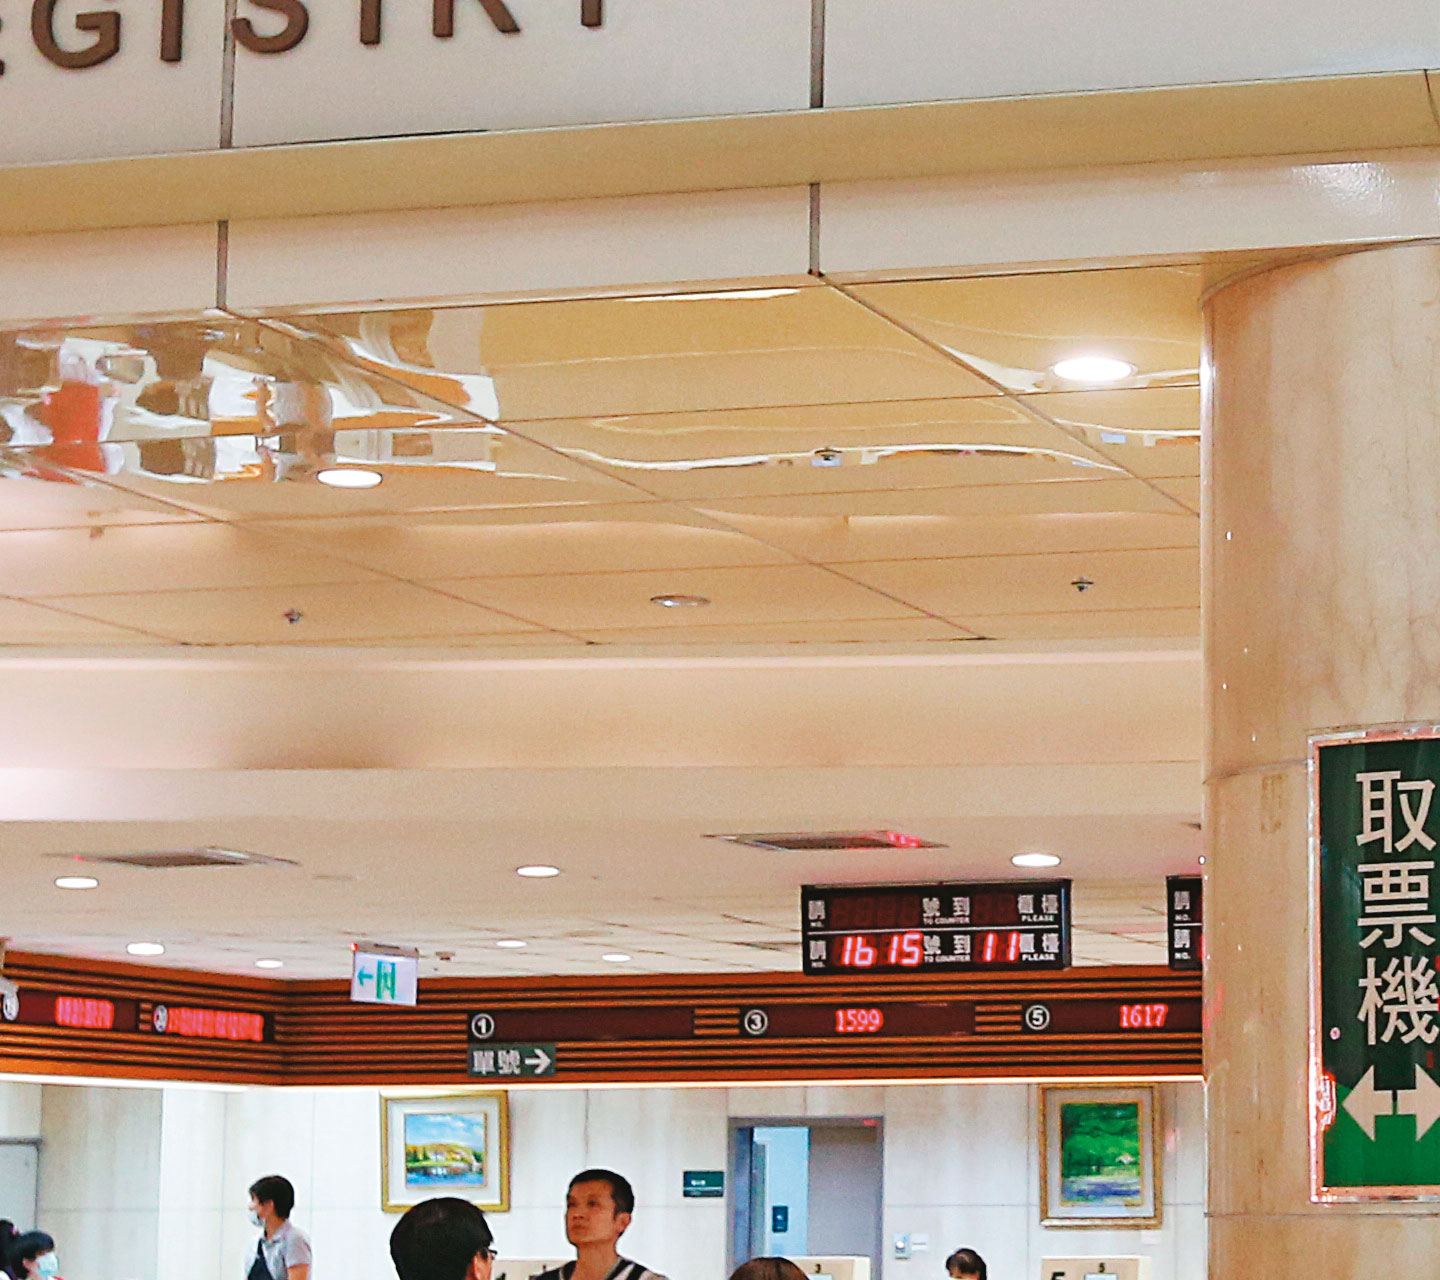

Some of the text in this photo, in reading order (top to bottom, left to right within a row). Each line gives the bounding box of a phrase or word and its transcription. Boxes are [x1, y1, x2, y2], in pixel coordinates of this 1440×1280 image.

[1021, 914, 1054, 922] PLEASE
[1355, 769, 1440, 1046] 取票機
[836, 1009, 883, 1032] 1599
[1121, 1004, 1167, 1028] 1617
[472, 1050, 520, 1075] 單號
